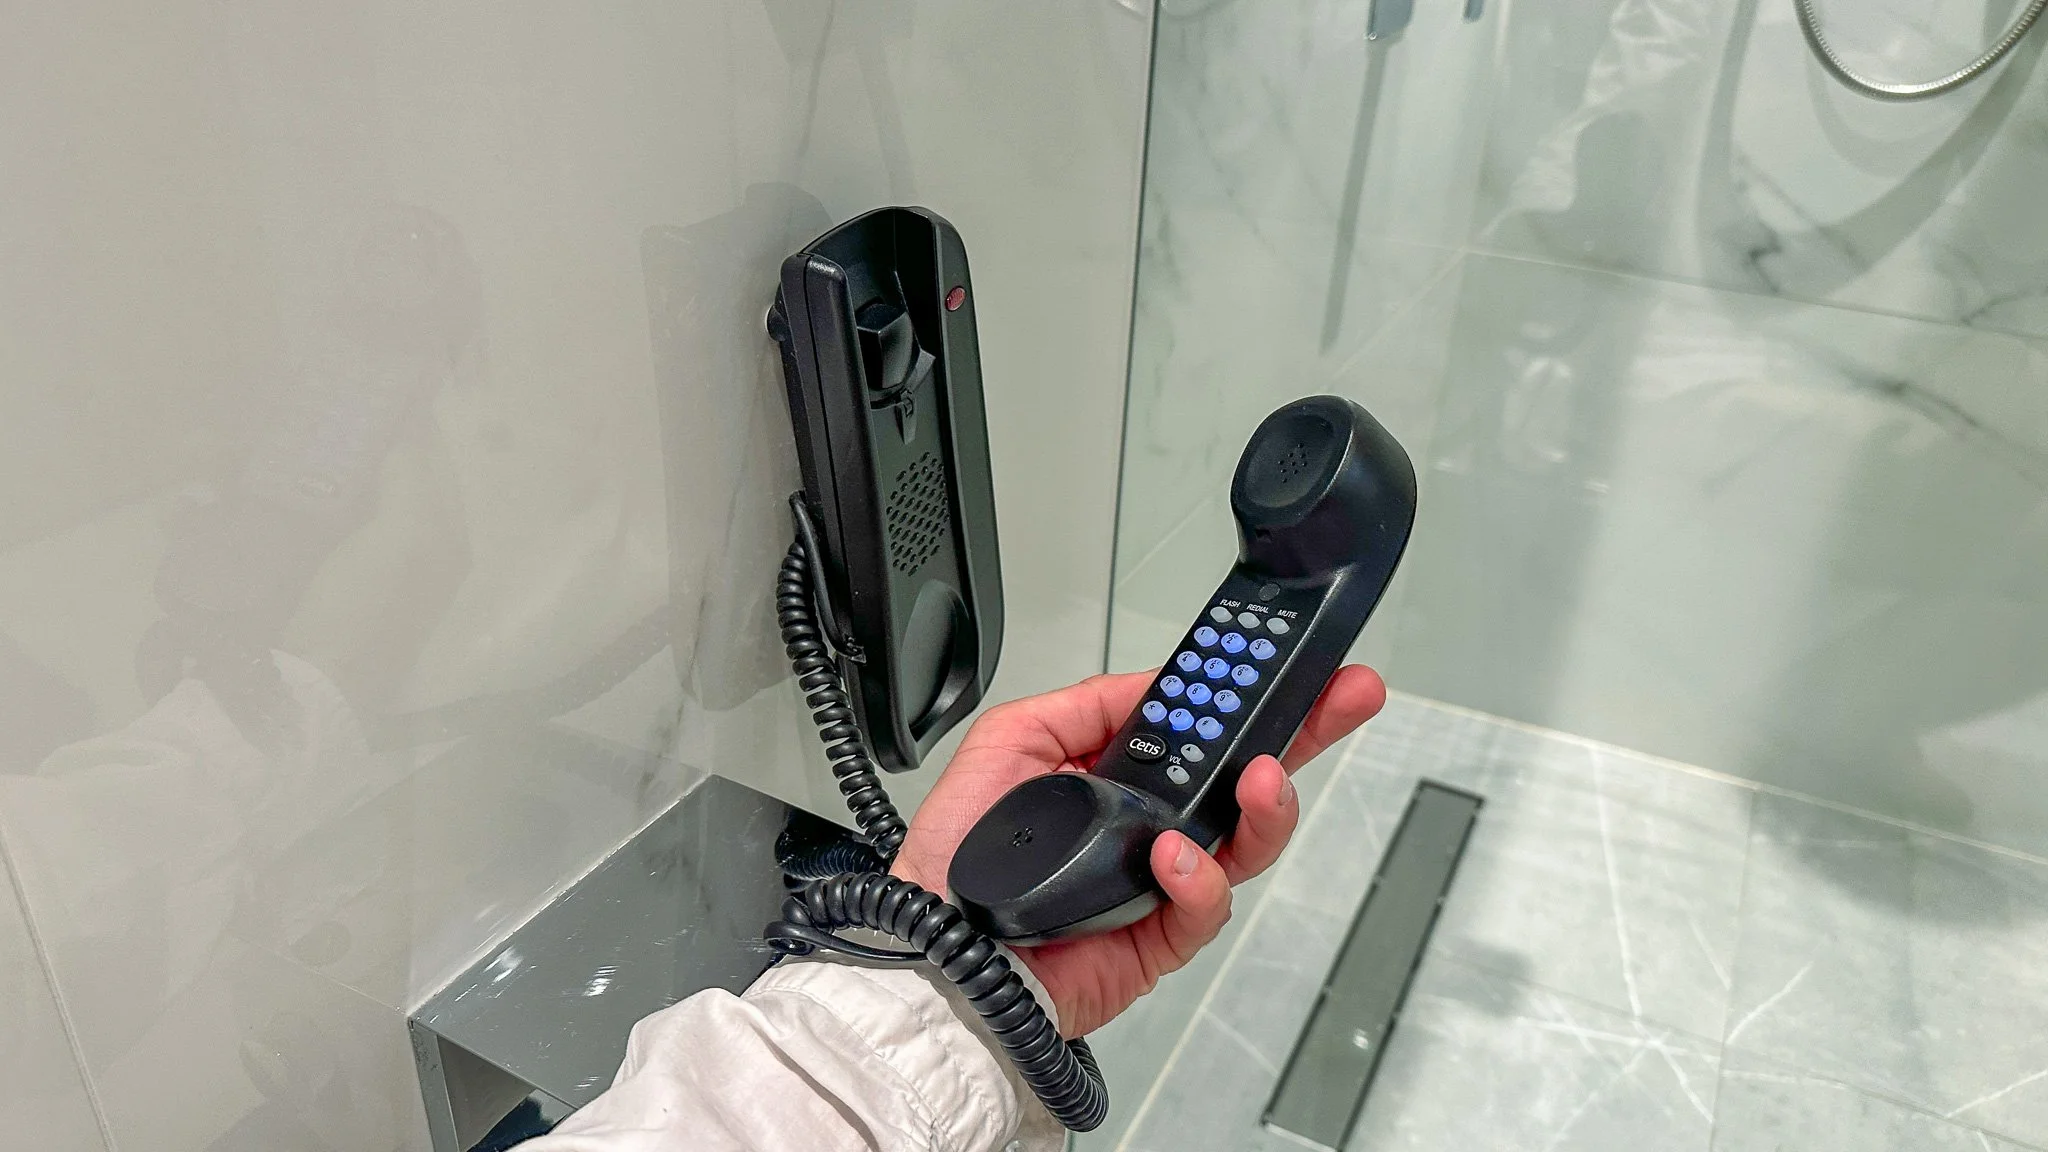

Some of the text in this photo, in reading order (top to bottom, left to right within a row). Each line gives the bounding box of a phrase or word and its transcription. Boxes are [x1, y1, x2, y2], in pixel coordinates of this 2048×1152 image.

[1220, 599, 1241, 608] FLASH
[1246, 603, 1270, 613] REDIAL
[1277, 609, 1299, 619] MUTE
[1129, 738, 1161, 756] Cetis
[1168, 755, 1182, 765] VOL
